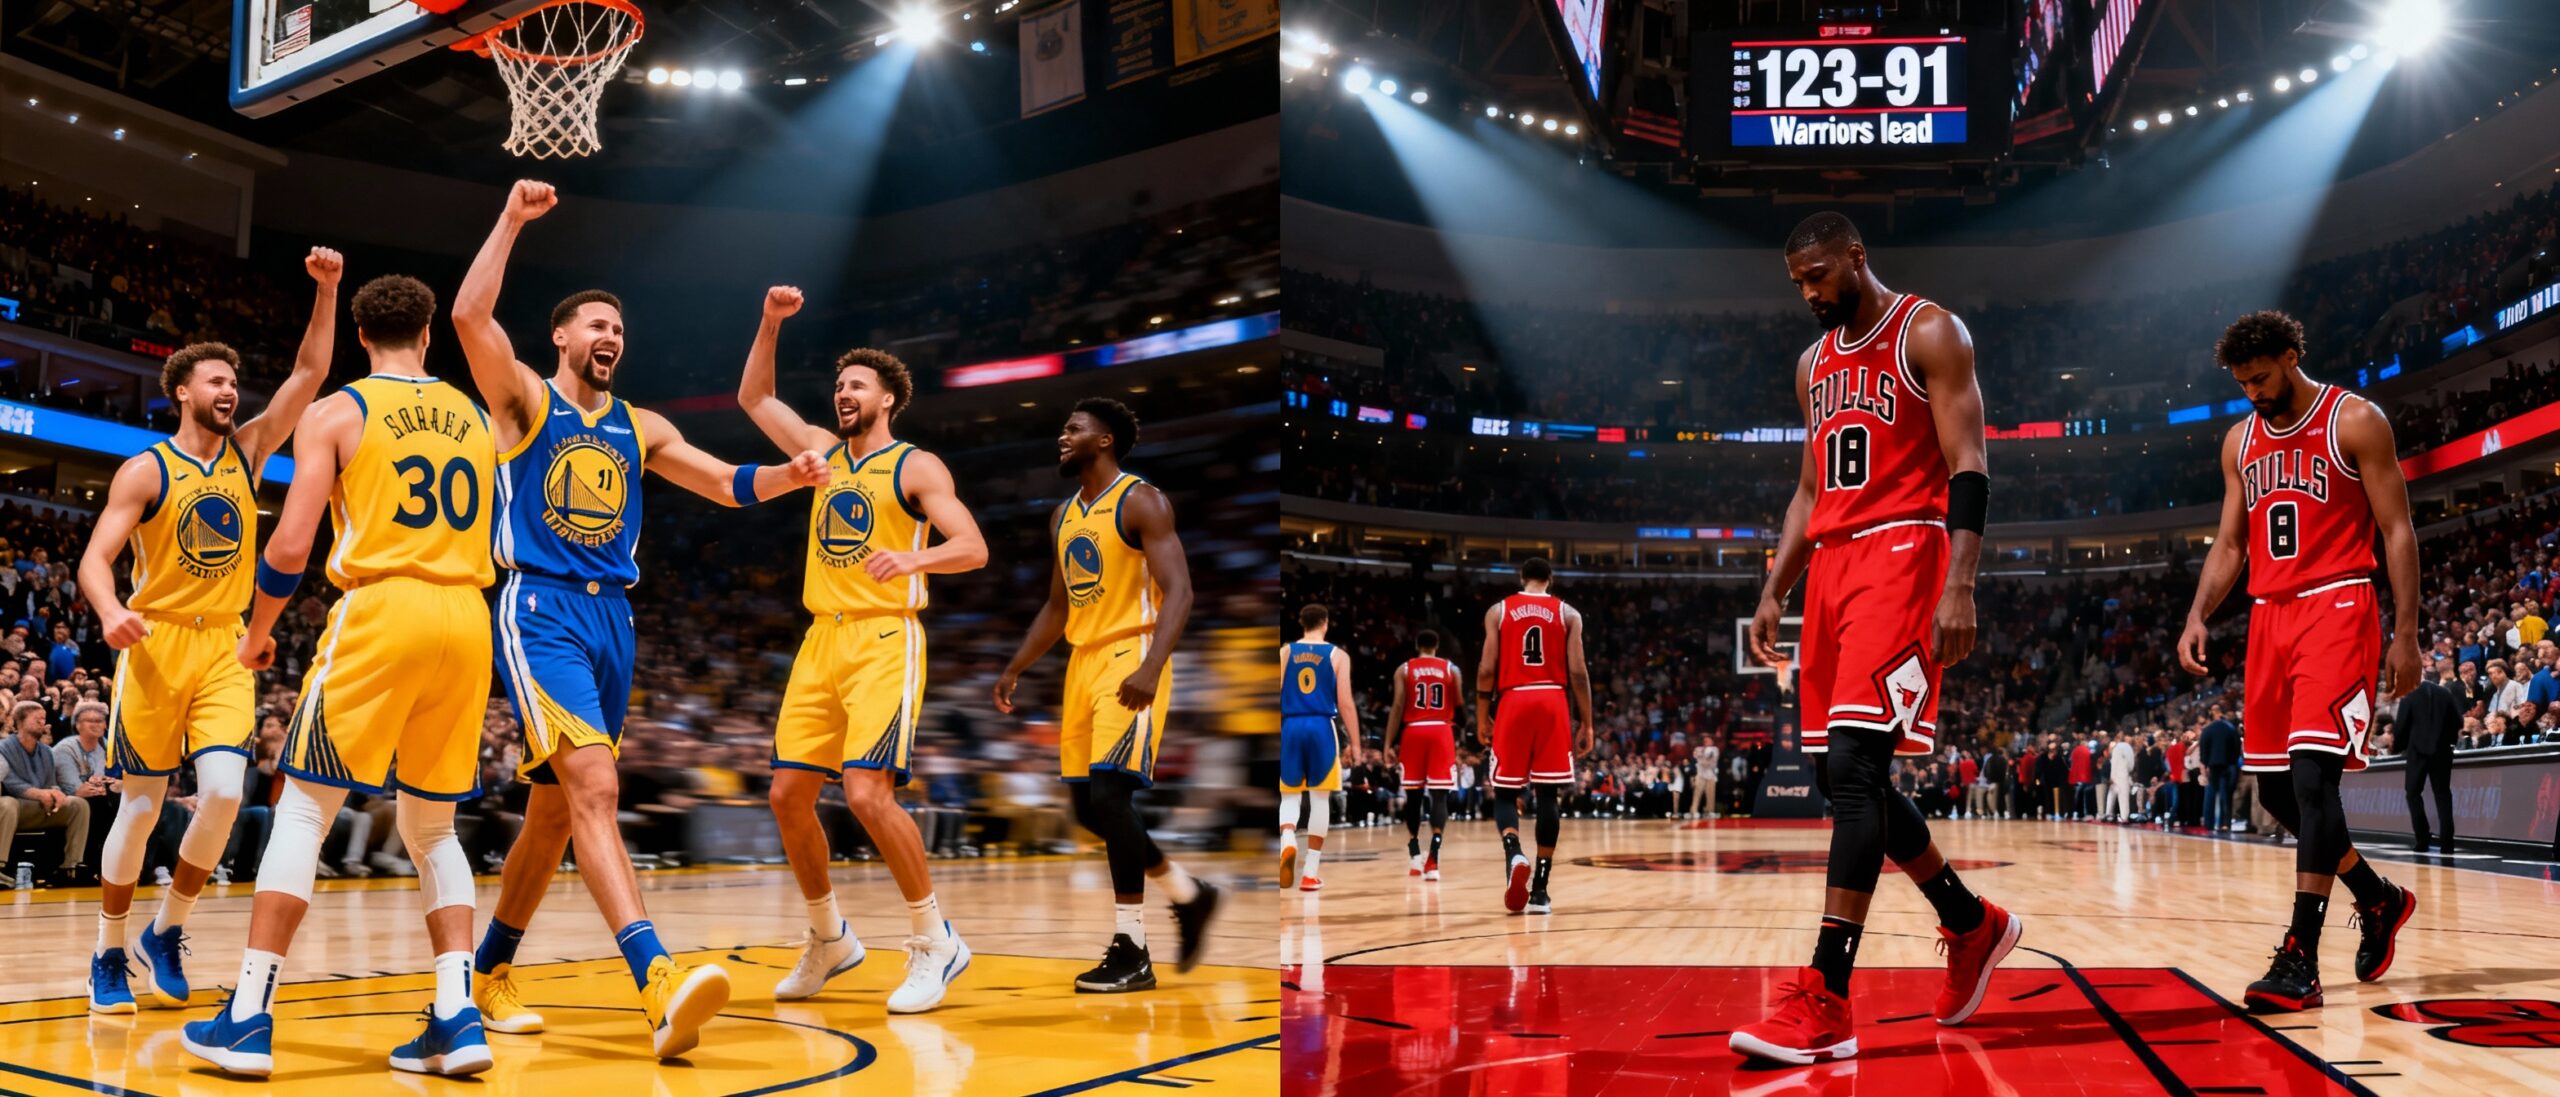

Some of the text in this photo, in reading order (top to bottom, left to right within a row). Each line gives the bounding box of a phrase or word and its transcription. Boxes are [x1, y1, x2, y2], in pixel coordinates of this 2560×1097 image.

[1757, 45, 1948, 108] 123-91
[1770, 113, 1933, 145] Warriors lead
[1809, 366, 1896, 441] BULLS
[1825, 424, 1870, 491] 18
[2242, 449, 2329, 512] BULLS
[392, 454, 479, 532] 30
[2267, 501, 2298, 560] 8
[1298, 667, 1316, 694] 0
